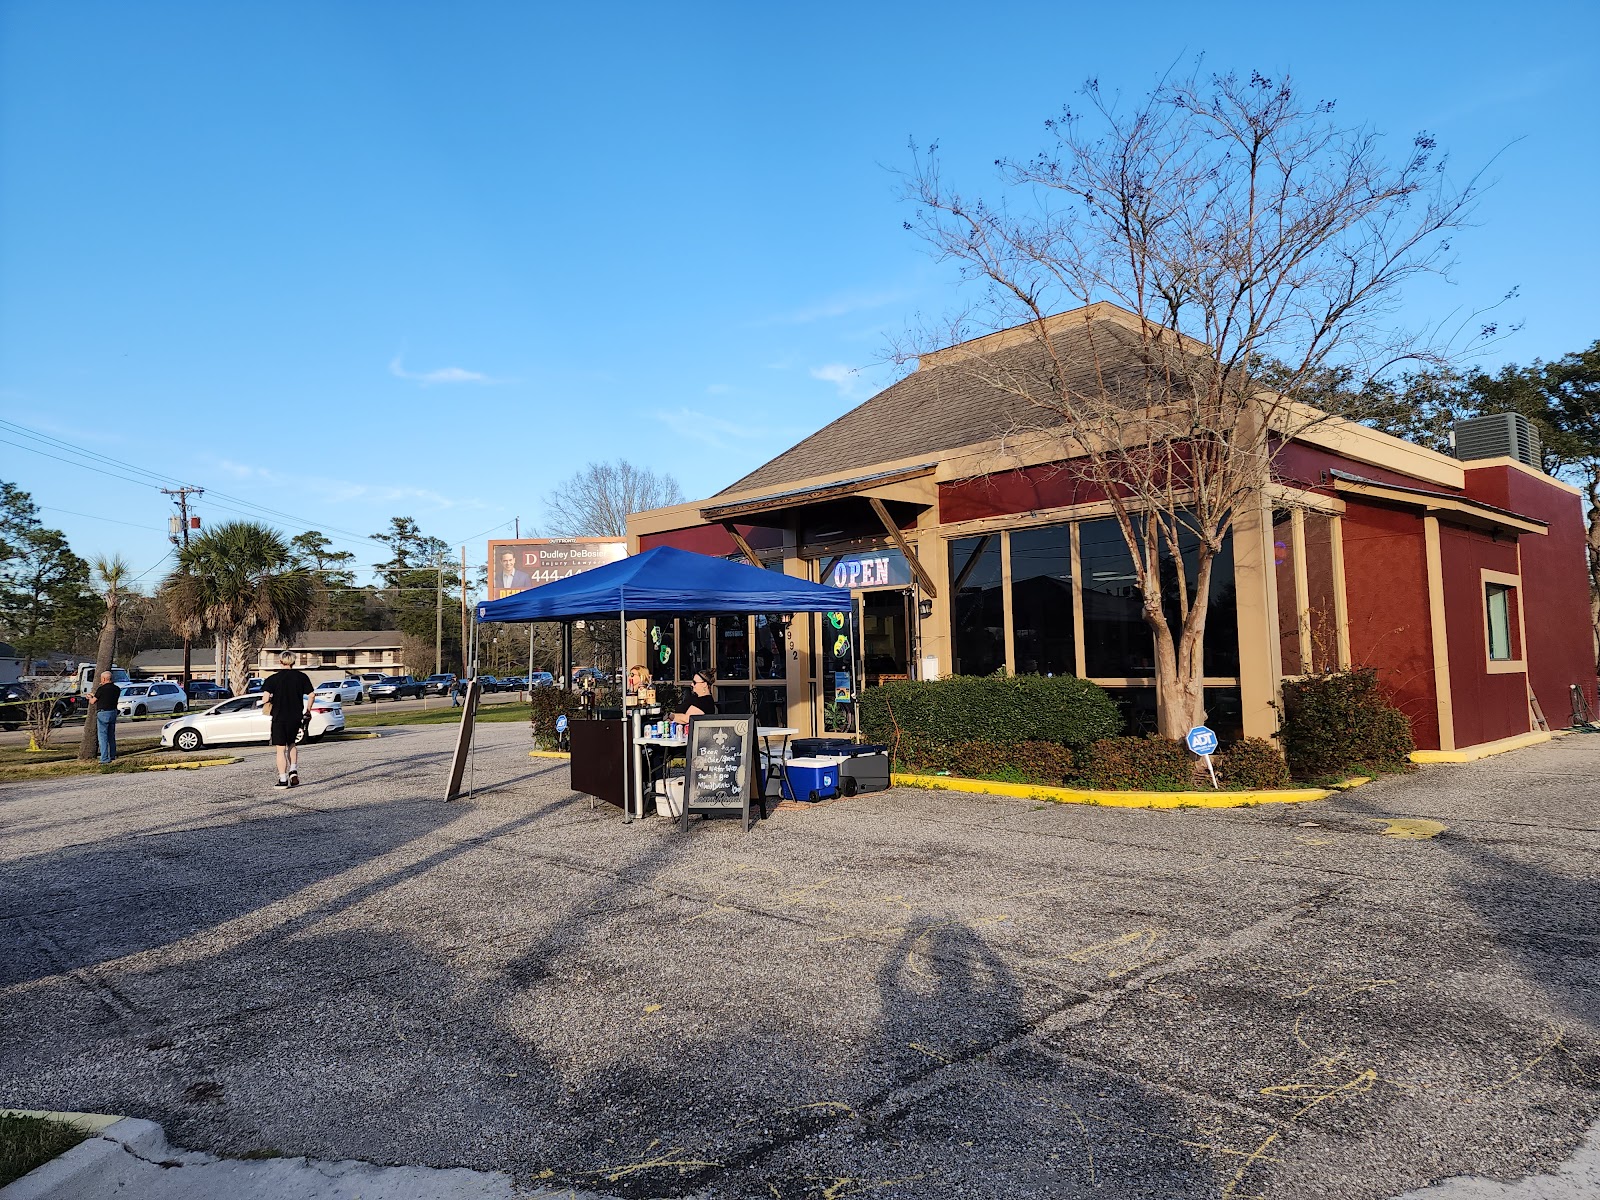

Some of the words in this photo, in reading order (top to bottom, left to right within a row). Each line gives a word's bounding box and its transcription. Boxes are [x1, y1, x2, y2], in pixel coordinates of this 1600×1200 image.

[525, 553, 537, 566] D
[540, 550, 568, 560] Dudley
[834, 558, 889, 588] OPEN
[1192, 732, 1213, 748] ADT
